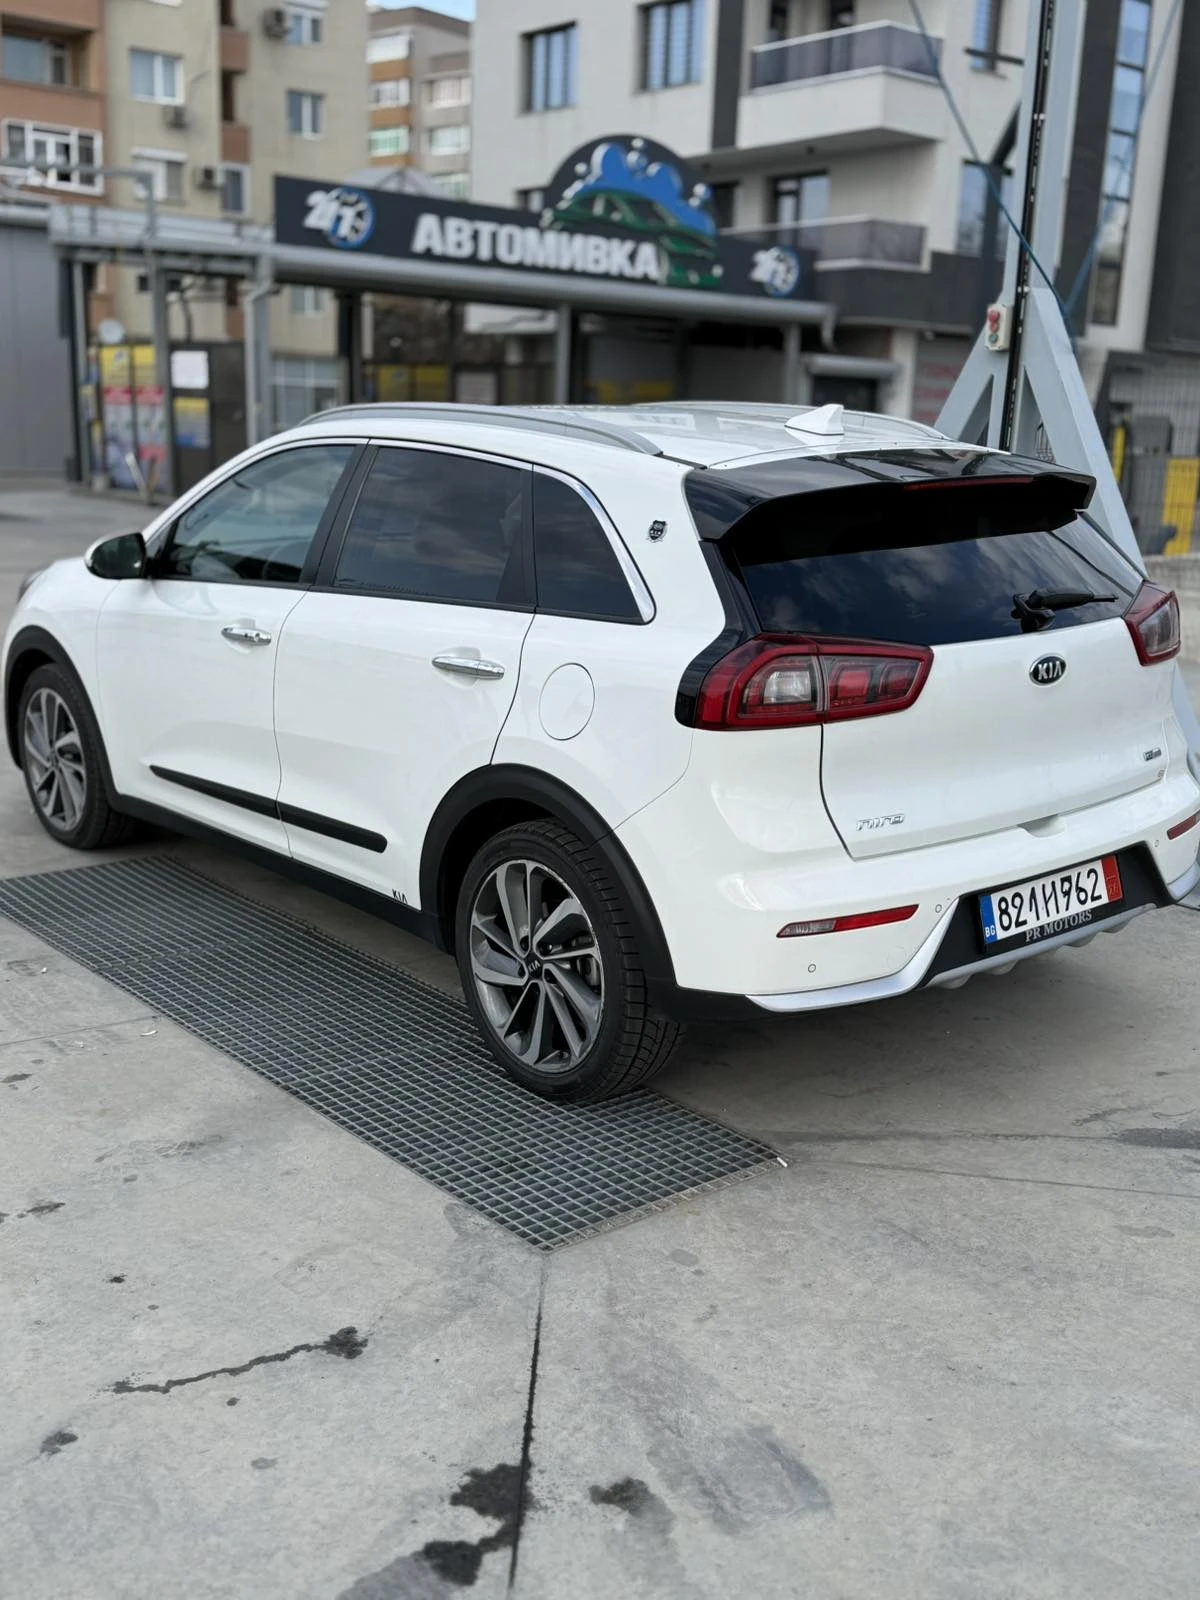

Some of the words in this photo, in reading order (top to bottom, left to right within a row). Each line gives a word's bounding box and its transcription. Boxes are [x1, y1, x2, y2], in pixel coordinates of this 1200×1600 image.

[411, 213, 659, 281] АВТОМИВКА
[1037, 661, 1062, 680] KIA
[391, 888, 408, 905] KIA
[985, 925, 996, 937] BG
[1026, 928, 1042, 942] PR
[1043, 910, 1092, 936] MOTORS
[528, 960, 541, 973] KIA
